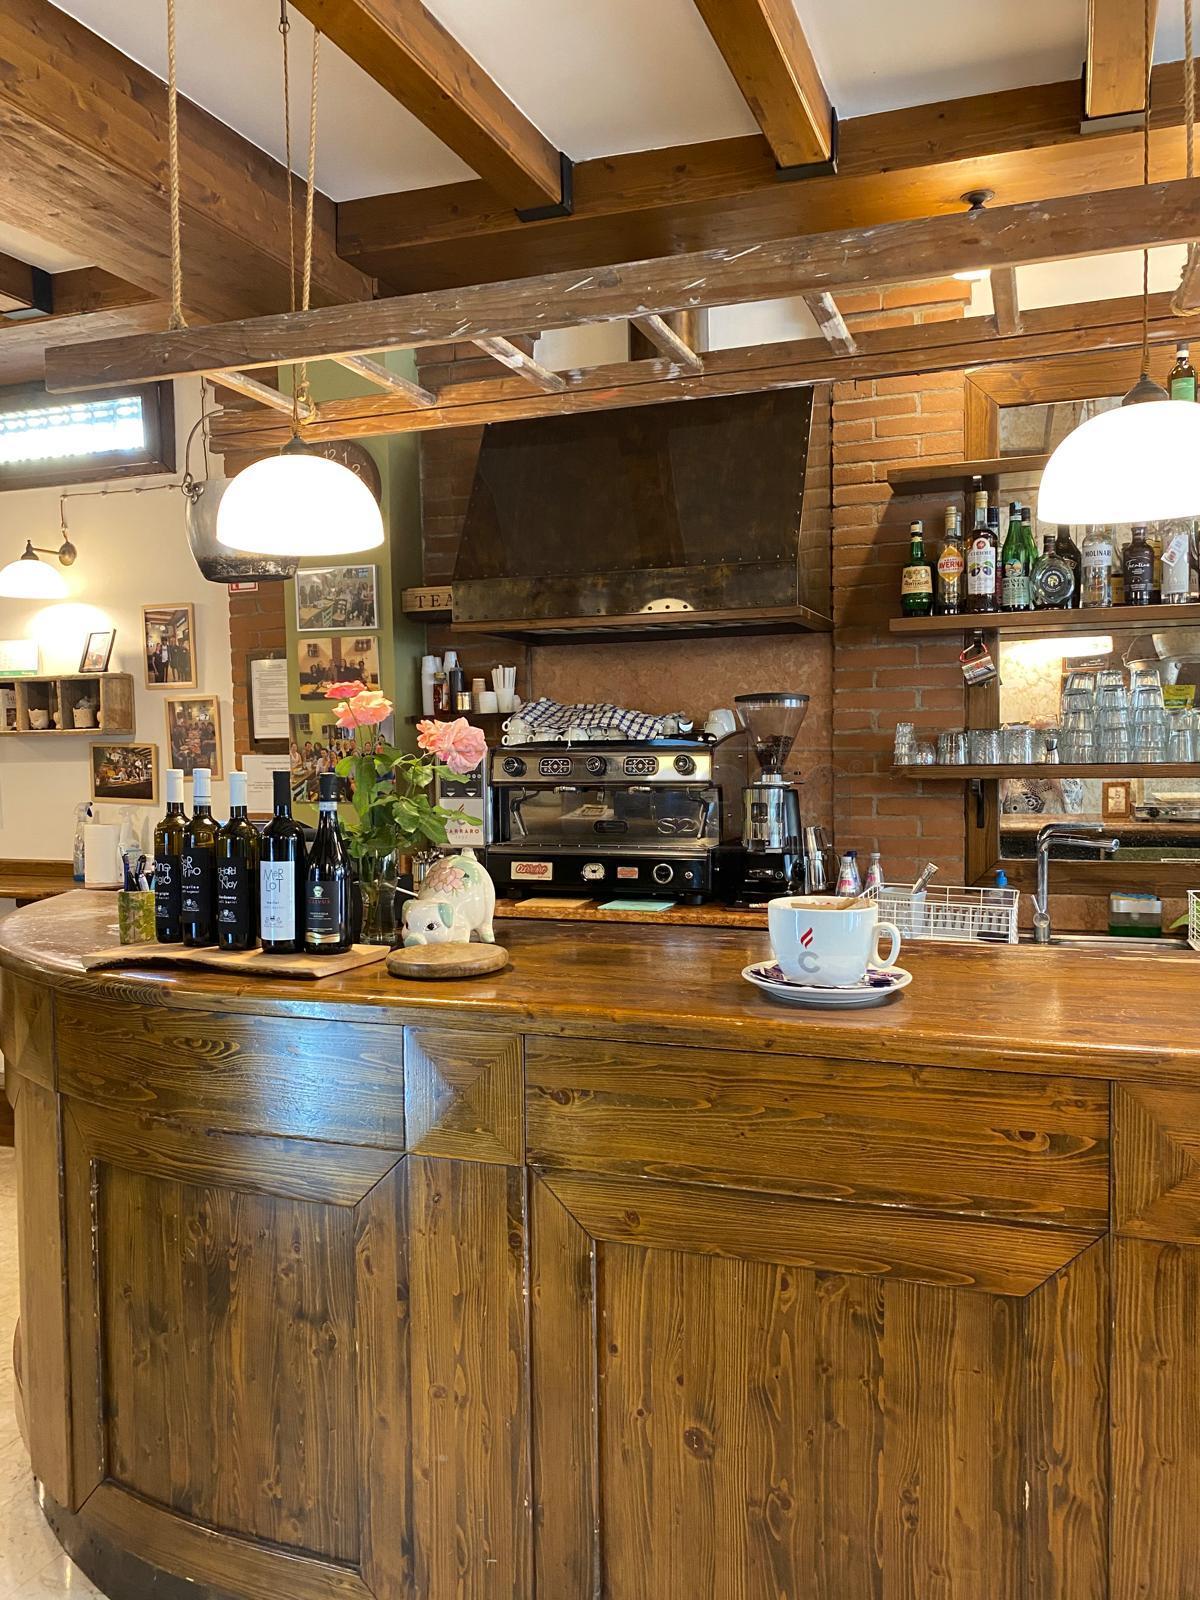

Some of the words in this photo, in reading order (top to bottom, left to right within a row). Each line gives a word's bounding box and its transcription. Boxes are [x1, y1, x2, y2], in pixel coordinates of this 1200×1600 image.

[323, 449, 336, 460] 12
[342, 451, 348, 465] 1
[939, 560, 963, 570] AVERNA
[798, 951, 821, 973] C
